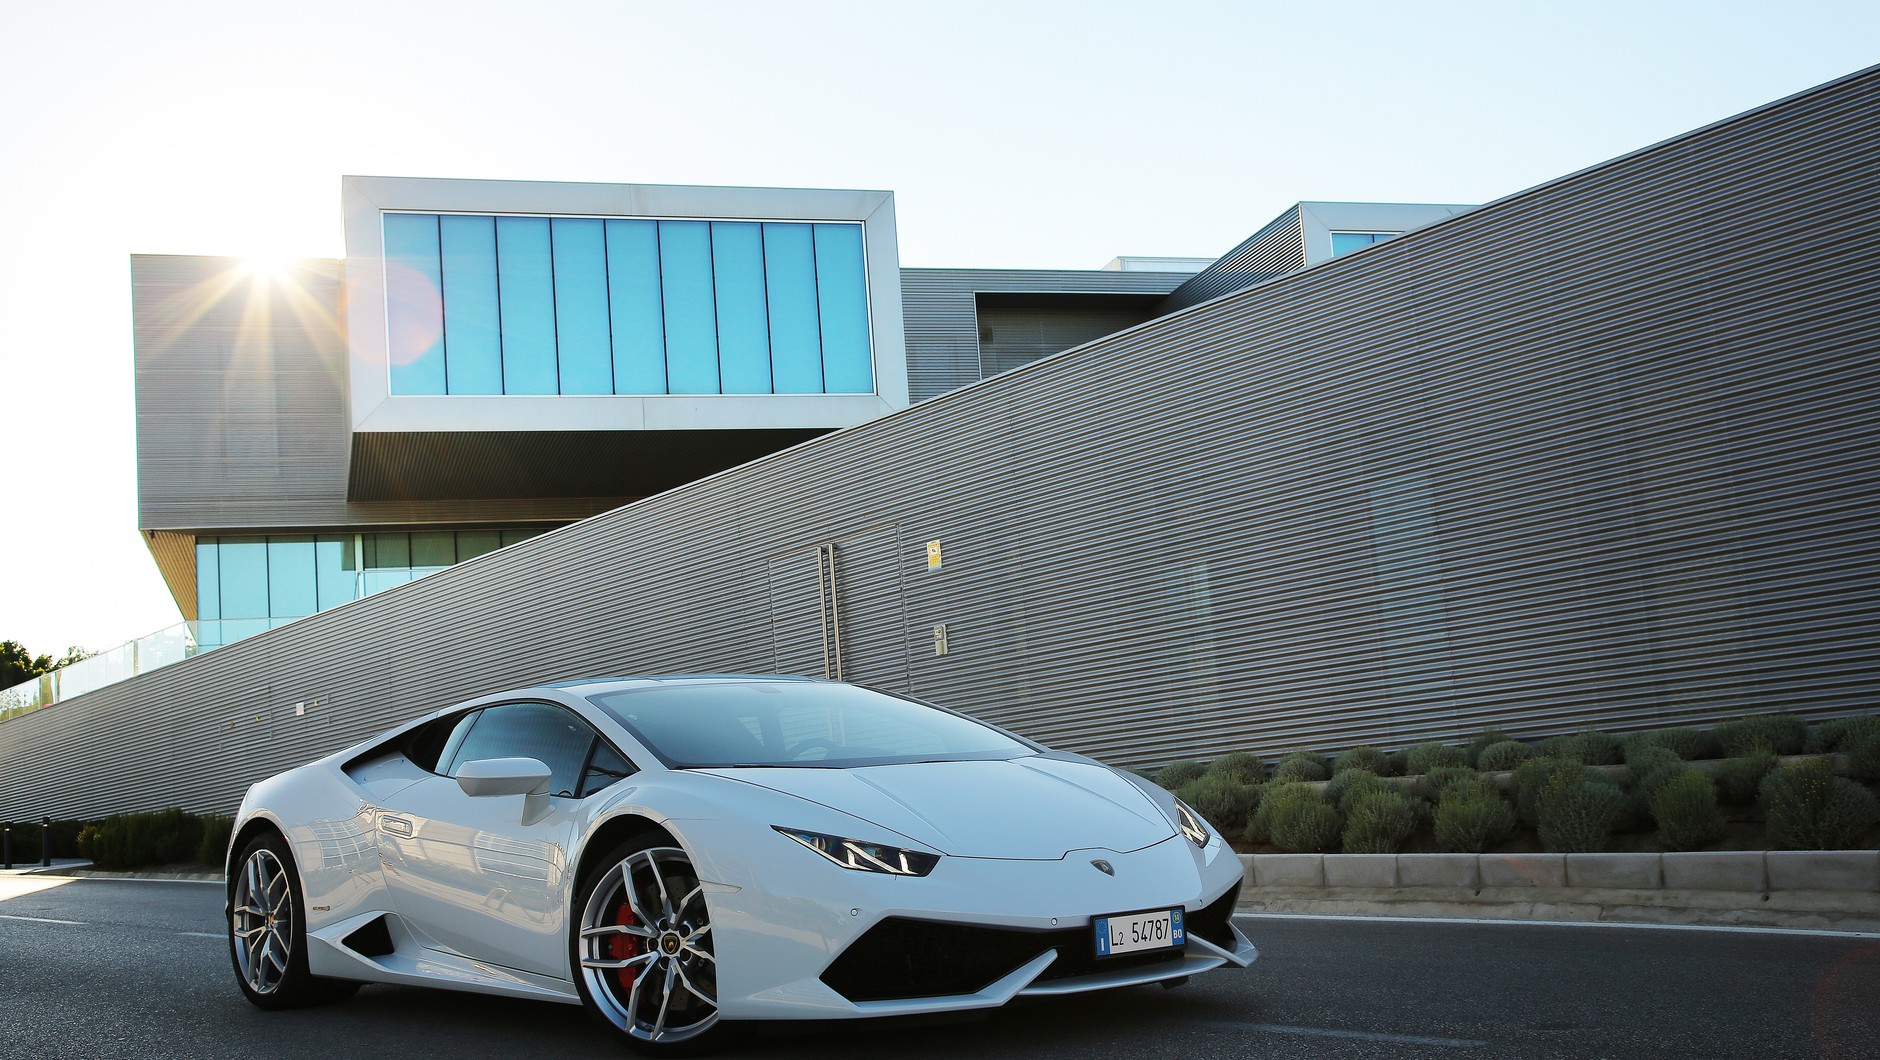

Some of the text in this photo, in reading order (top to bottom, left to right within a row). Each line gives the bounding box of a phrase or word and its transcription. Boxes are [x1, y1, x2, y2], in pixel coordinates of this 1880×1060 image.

[1110, 918, 1169, 946] L2 54787
[1173, 928, 1182, 939] BO
